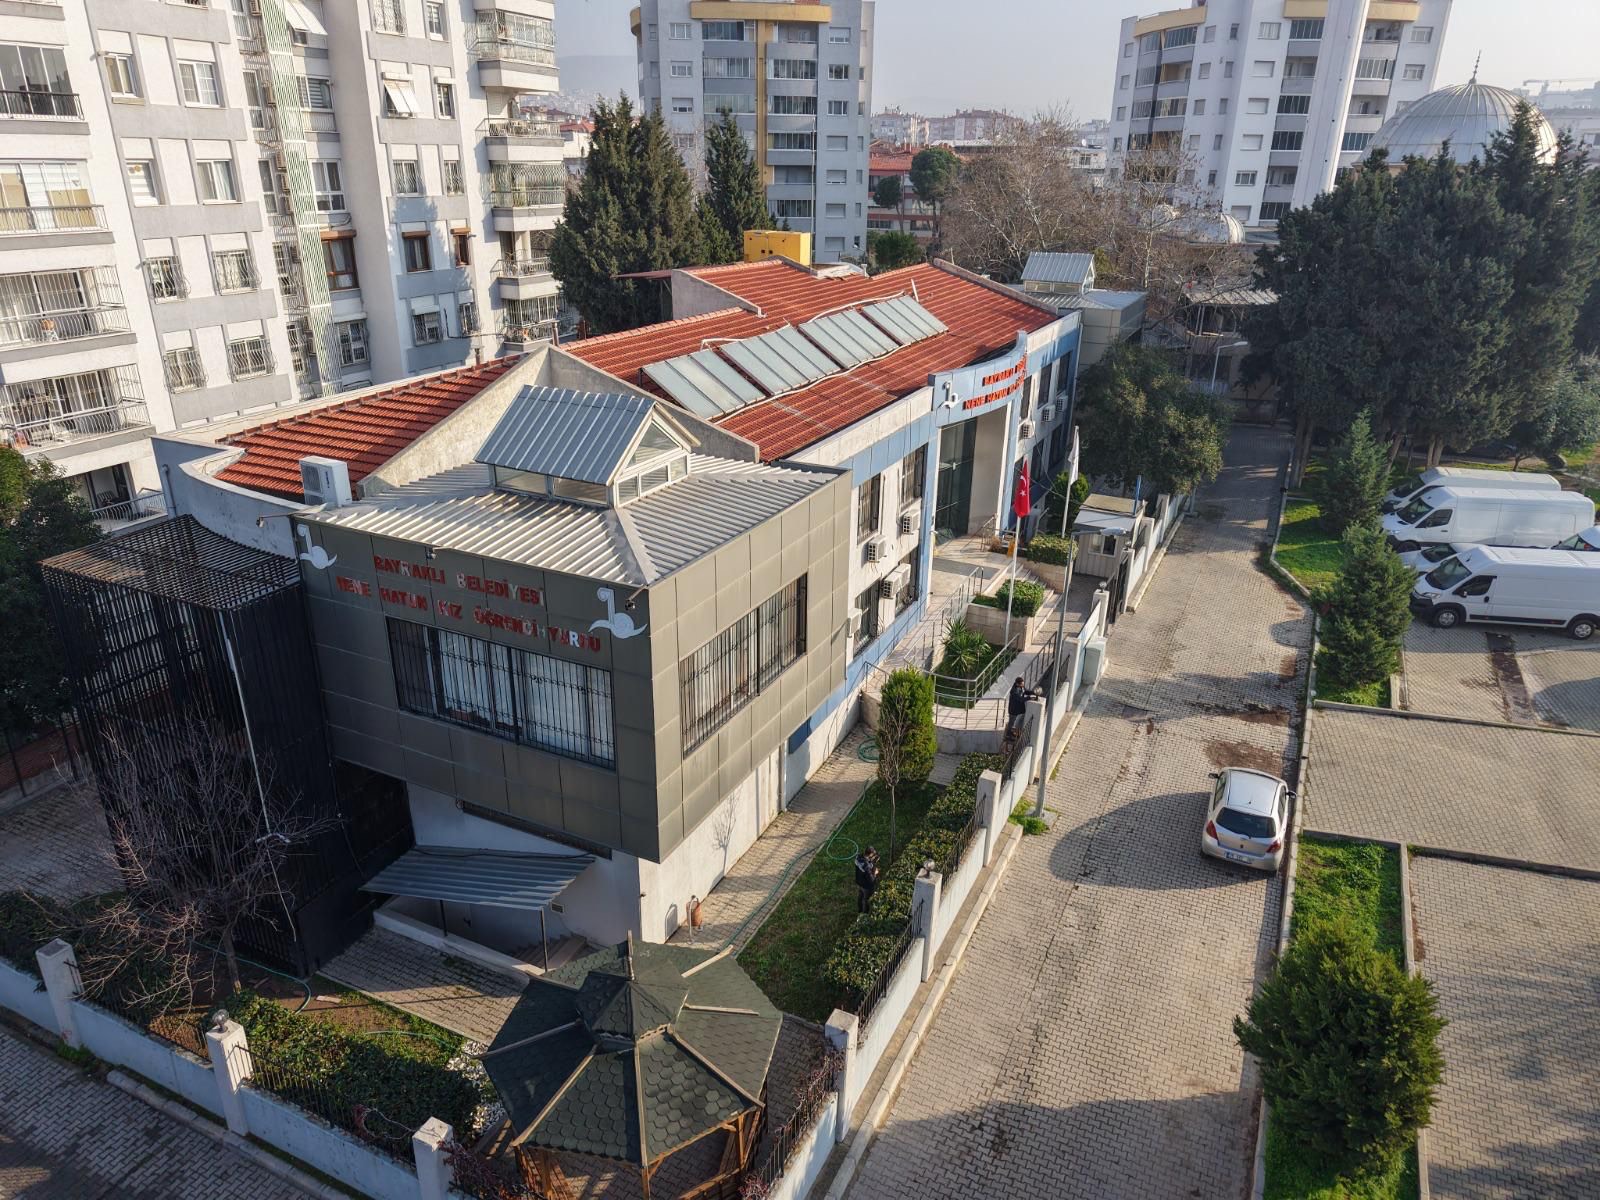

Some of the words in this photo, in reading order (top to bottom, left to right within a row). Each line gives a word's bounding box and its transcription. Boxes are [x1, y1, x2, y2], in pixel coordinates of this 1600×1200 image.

[336, 575, 372, 597] NENE
[379, 586, 428, 611] HATUN
[438, 599, 463, 620] KIZ
[373, 555, 446, 584] BAYRAKLI
[456, 572, 545, 606] BELEDİYESİ
